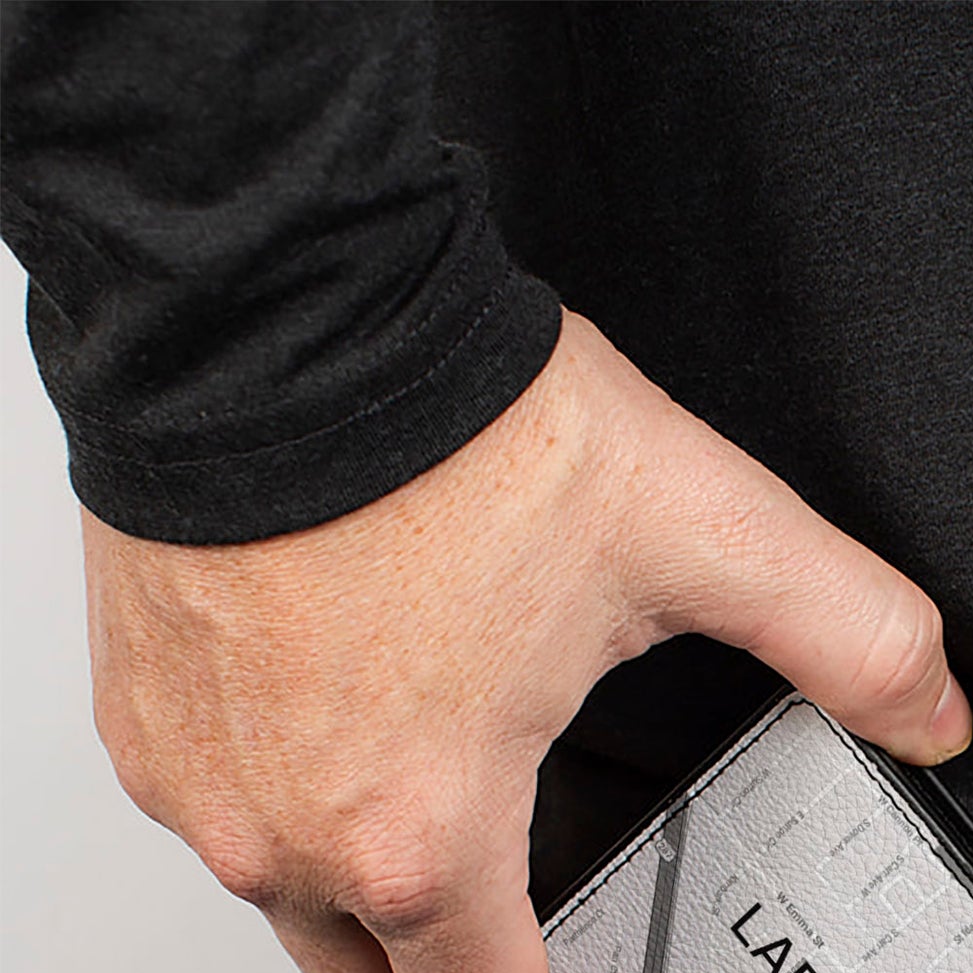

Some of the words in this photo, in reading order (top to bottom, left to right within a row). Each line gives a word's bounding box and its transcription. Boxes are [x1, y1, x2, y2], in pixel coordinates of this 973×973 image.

[867, 873, 884, 890] Ave
[776, 891, 788, 904] W
[785, 902, 814, 937] Emma
[811, 934, 826, 949] St
[876, 933, 893, 950] Carr
[861, 947, 878, 963] Ave
